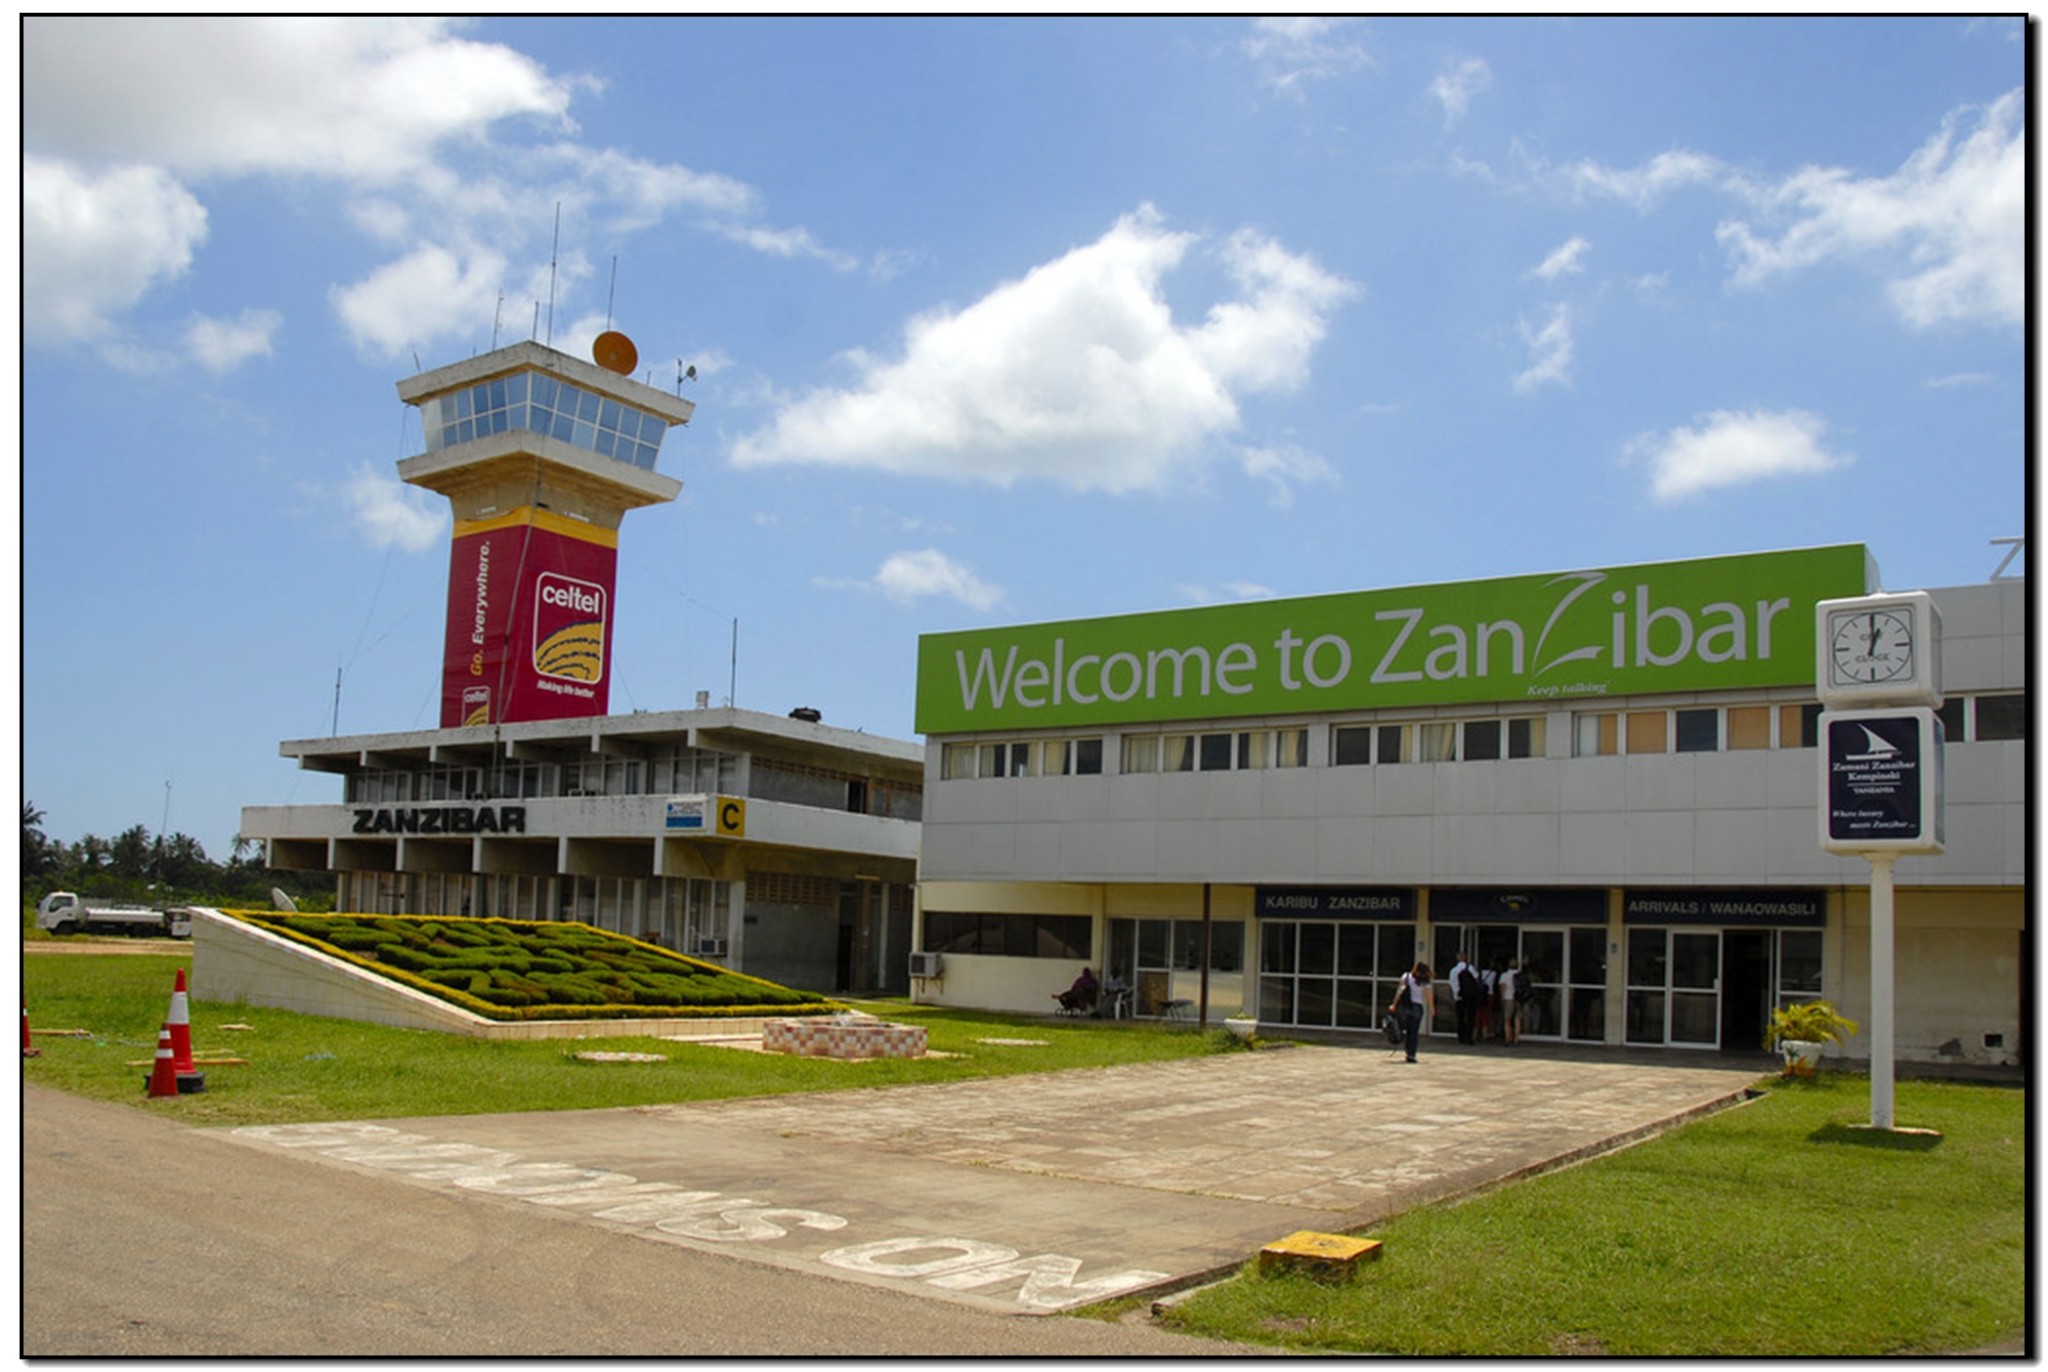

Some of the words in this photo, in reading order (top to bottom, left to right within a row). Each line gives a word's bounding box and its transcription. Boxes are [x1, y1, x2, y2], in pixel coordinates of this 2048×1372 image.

[472, 541, 490, 645] Everywhere.
[542, 585, 600, 614] celtel
[955, 638, 1257, 711] Welcome
[1274, 628, 1352, 690] to
[1369, 570, 1790, 684] ZanZibar
[469, 649, 484, 676] Go.
[1848, 771, 1900, 782] Kempinski
[1872, 761, 1915, 771] Zanzibar
[353, 807, 525, 834] ZANZIBAR
[722, 803, 740, 831] C
[1266, 896, 1318, 909] KARIBU
[1328, 896, 1400, 910] ZANZIBAR
[1628, 900, 1699, 914] ARRIVALS
[1710, 902, 1816, 916] WANAOWASILI
[819, 1236, 1172, 1309] NO
